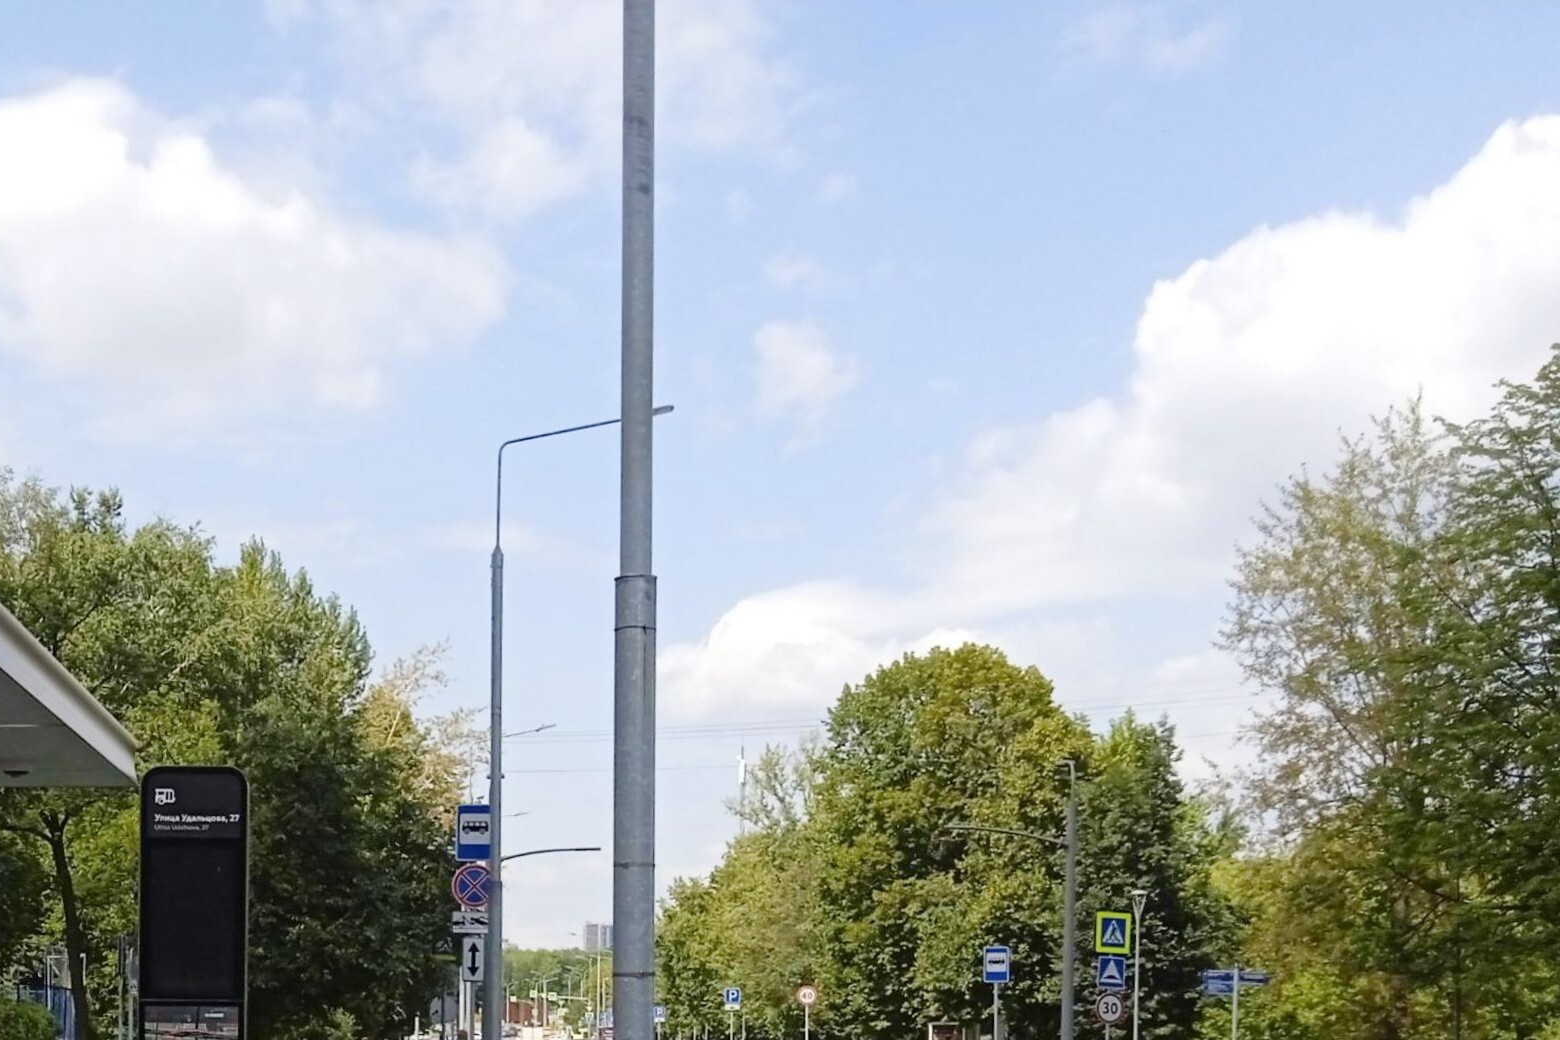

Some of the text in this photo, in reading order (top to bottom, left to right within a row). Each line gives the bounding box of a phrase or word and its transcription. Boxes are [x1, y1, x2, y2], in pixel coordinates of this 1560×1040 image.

[154, 813, 240, 823] Улица Удальцова, 27
[729, 990, 738, 1000] P
[802, 991, 813, 1000] 40
[1103, 1003, 1118, 1014] 30
